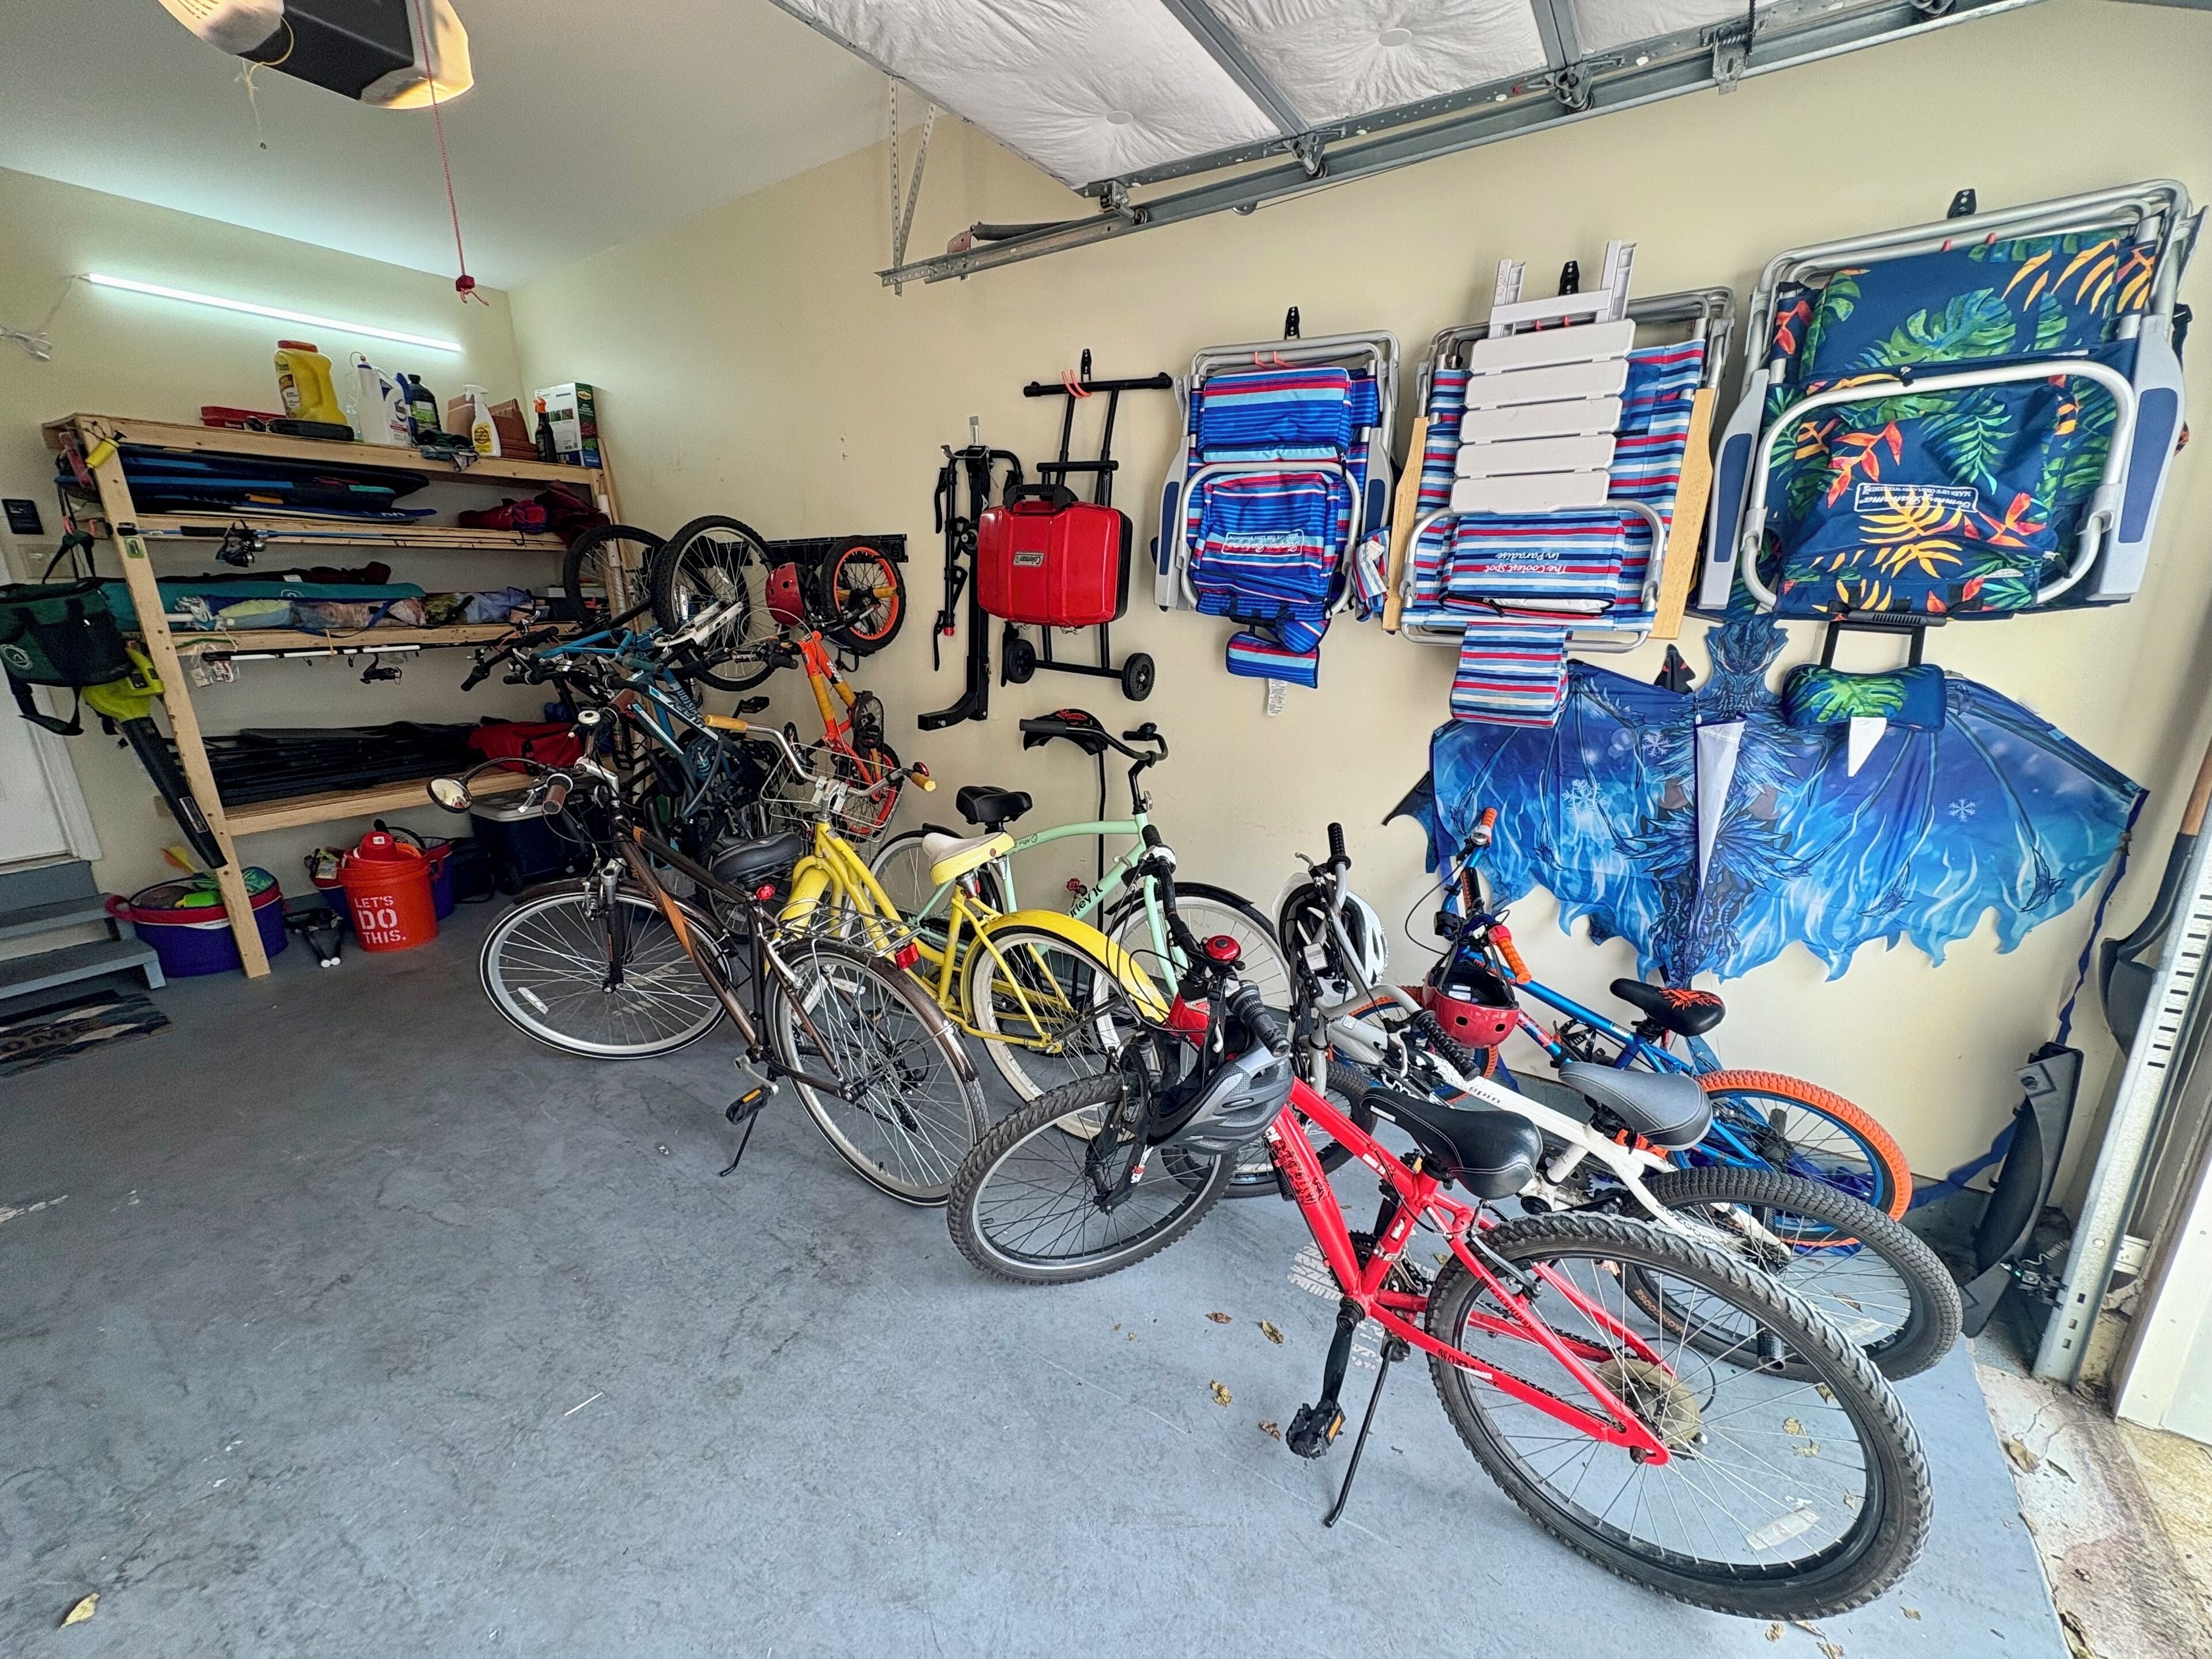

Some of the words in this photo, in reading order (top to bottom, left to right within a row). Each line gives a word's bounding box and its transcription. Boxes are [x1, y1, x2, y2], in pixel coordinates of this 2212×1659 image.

[1859, 495, 1924, 505] Bahama
[1925, 494, 1971, 509] Tommy
[1228, 542, 1266, 553] Bahama
[1267, 540, 1300, 552] Tommy
[1020, 556, 1041, 565] Coleman
[1495, 552, 1544, 562] Paradise
[1544, 552, 1559, 560] in
[1483, 562, 1507, 573] Spot
[1506, 564, 1546, 574] Coolest
[1546, 565, 1567, 574] The
[1019, 838, 1031, 846] FUN
[354, 895, 394, 908] LET'S
[358, 908, 398, 930] DO
[362, 930, 407, 945] THIS.
